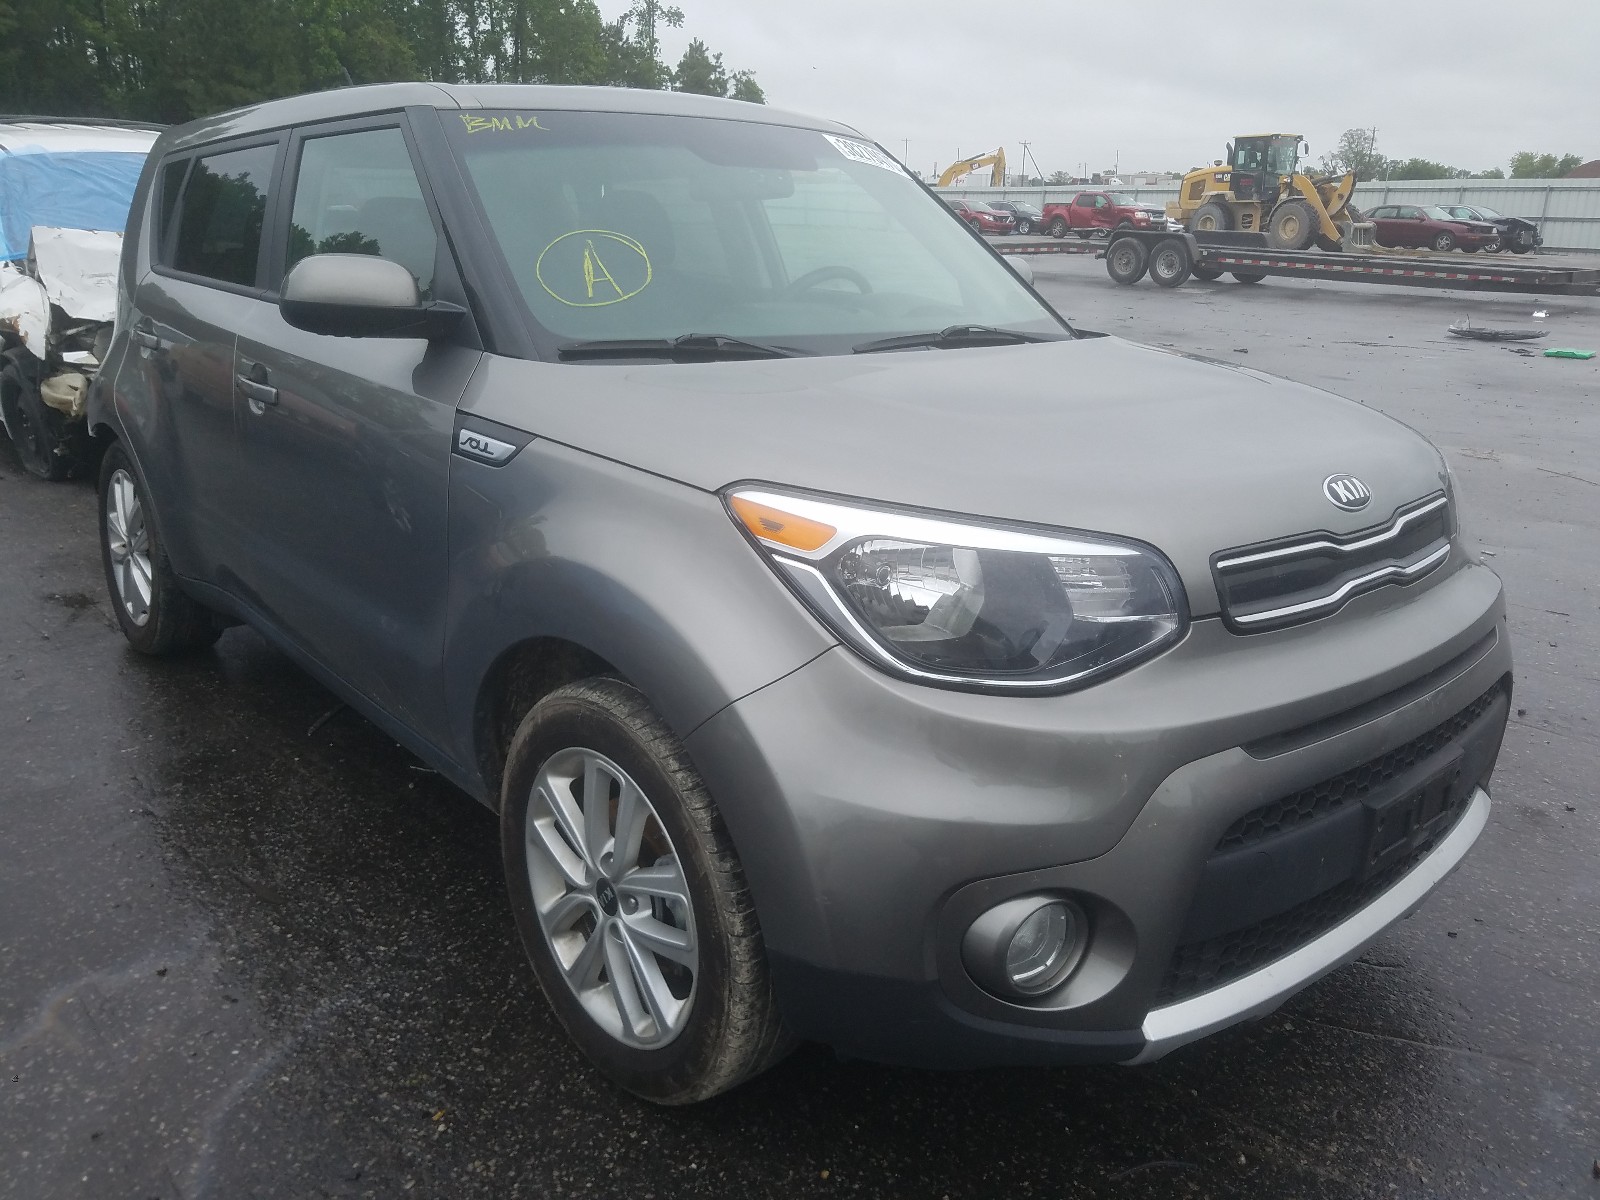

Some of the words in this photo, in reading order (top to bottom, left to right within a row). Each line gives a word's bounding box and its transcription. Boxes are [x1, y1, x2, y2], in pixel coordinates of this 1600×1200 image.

[583, 239, 625, 298] A
[459, 436, 495, 456] SOUL
[1329, 477, 1370, 503] KIA
